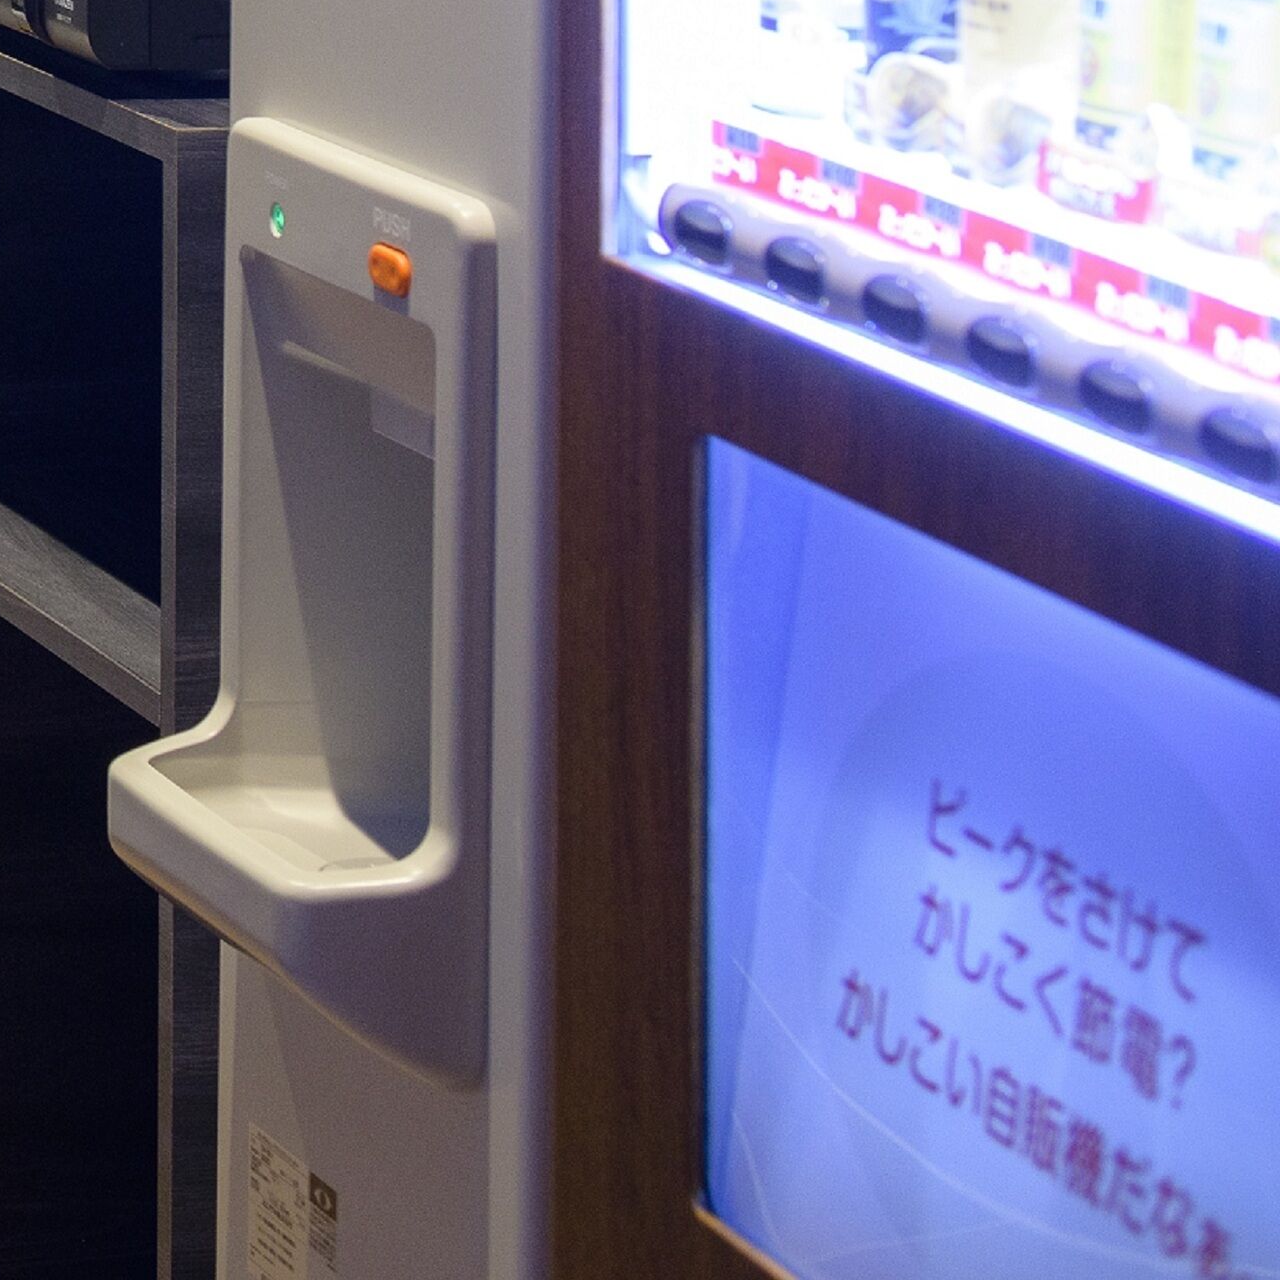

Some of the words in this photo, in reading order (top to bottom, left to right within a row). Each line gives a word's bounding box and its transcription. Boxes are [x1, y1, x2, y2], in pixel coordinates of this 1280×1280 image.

[926, 776, 1208, 1004] ピークをさけて
